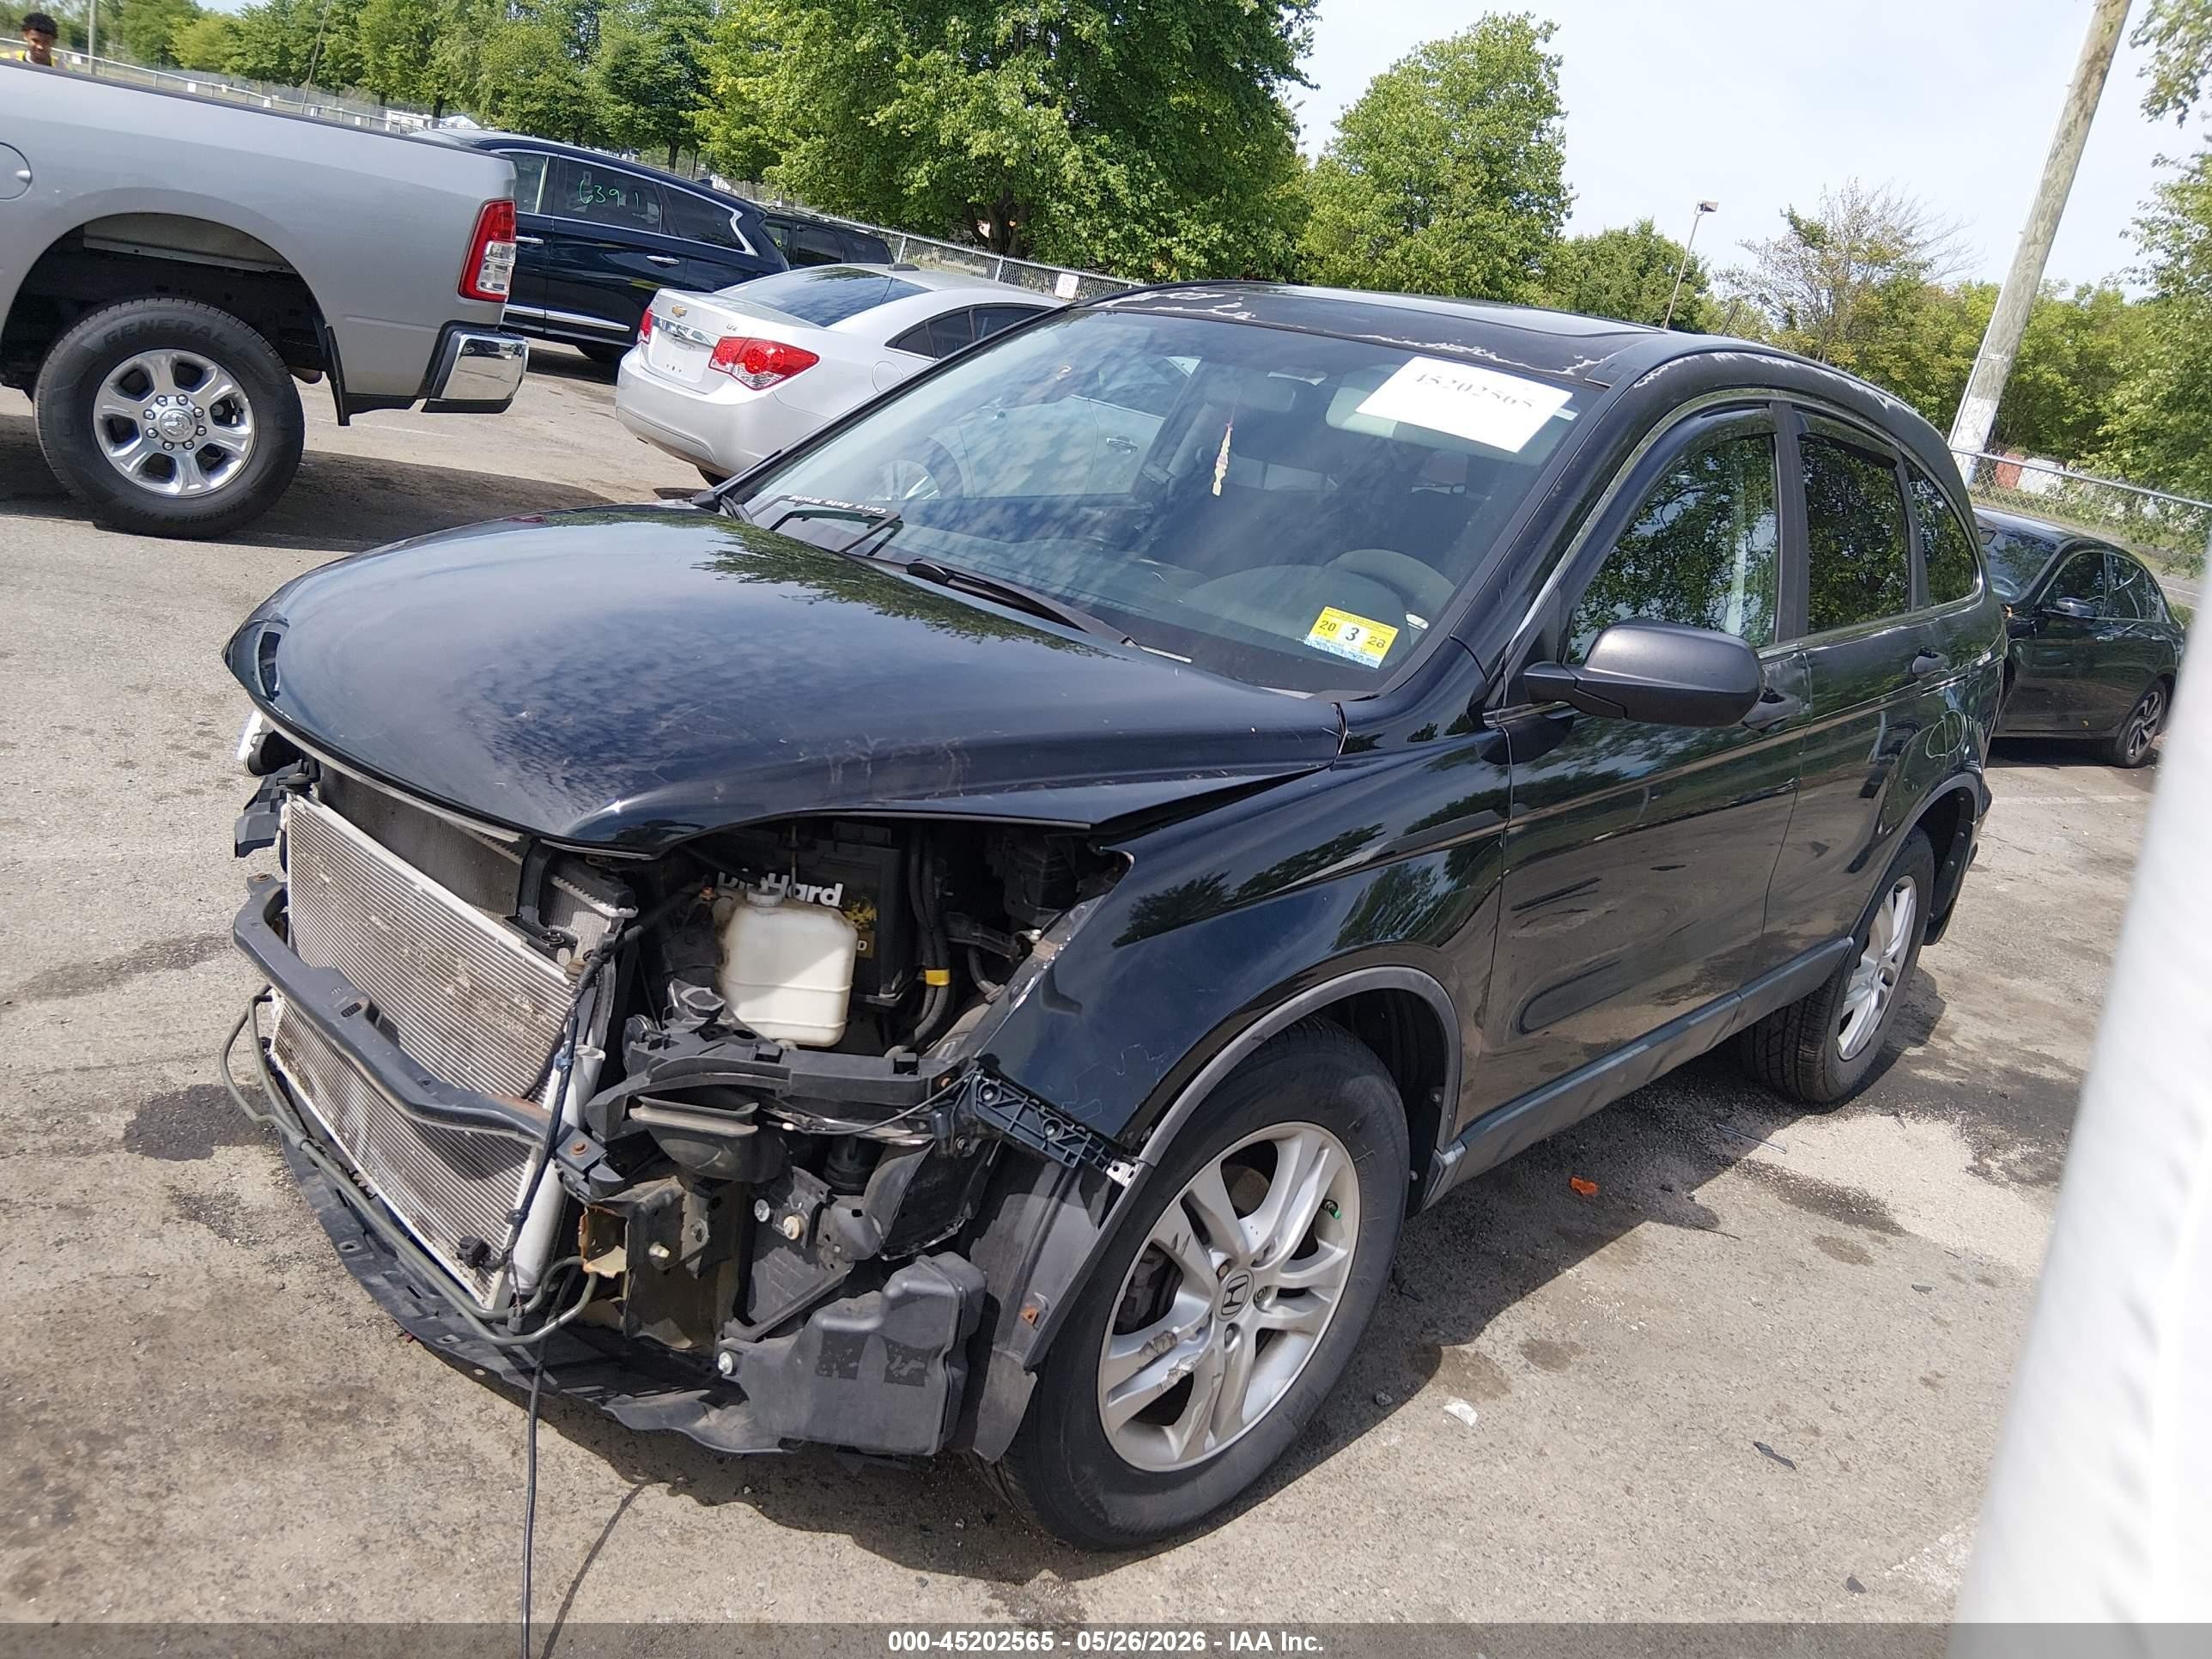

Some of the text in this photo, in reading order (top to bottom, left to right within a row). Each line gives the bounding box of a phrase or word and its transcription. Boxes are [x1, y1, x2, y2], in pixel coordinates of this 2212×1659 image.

[102, 318, 228, 347] GENERAL
[787, 495, 821, 505] World
[824, 499, 854, 509] Auto
[1319, 620, 1337, 632] 20
[1345, 627, 1360, 641] 3
